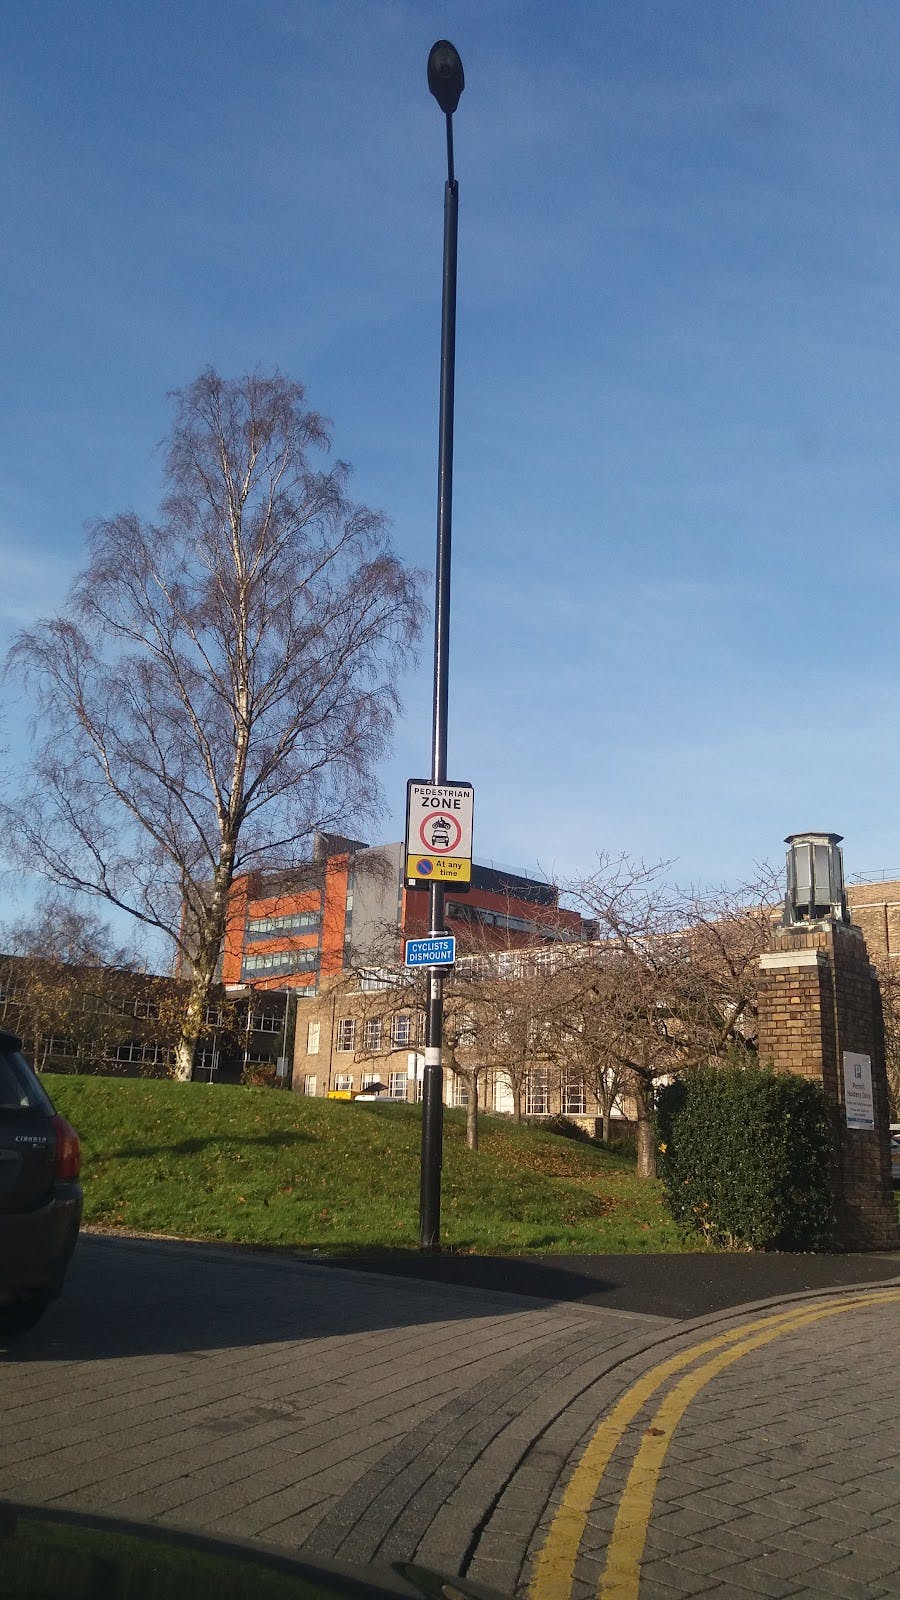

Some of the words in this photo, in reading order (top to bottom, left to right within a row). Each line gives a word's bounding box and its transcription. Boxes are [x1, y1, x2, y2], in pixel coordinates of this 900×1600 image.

[414, 787, 470, 798] PEDESTRIAN
[421, 796, 461, 810] ZONE
[436, 860, 446, 868] At
[448, 862, 463, 870] any
[440, 869, 458, 877] time
[412, 941, 449, 952] CYCLISTS
[409, 950, 452, 962] DISMOUNT
